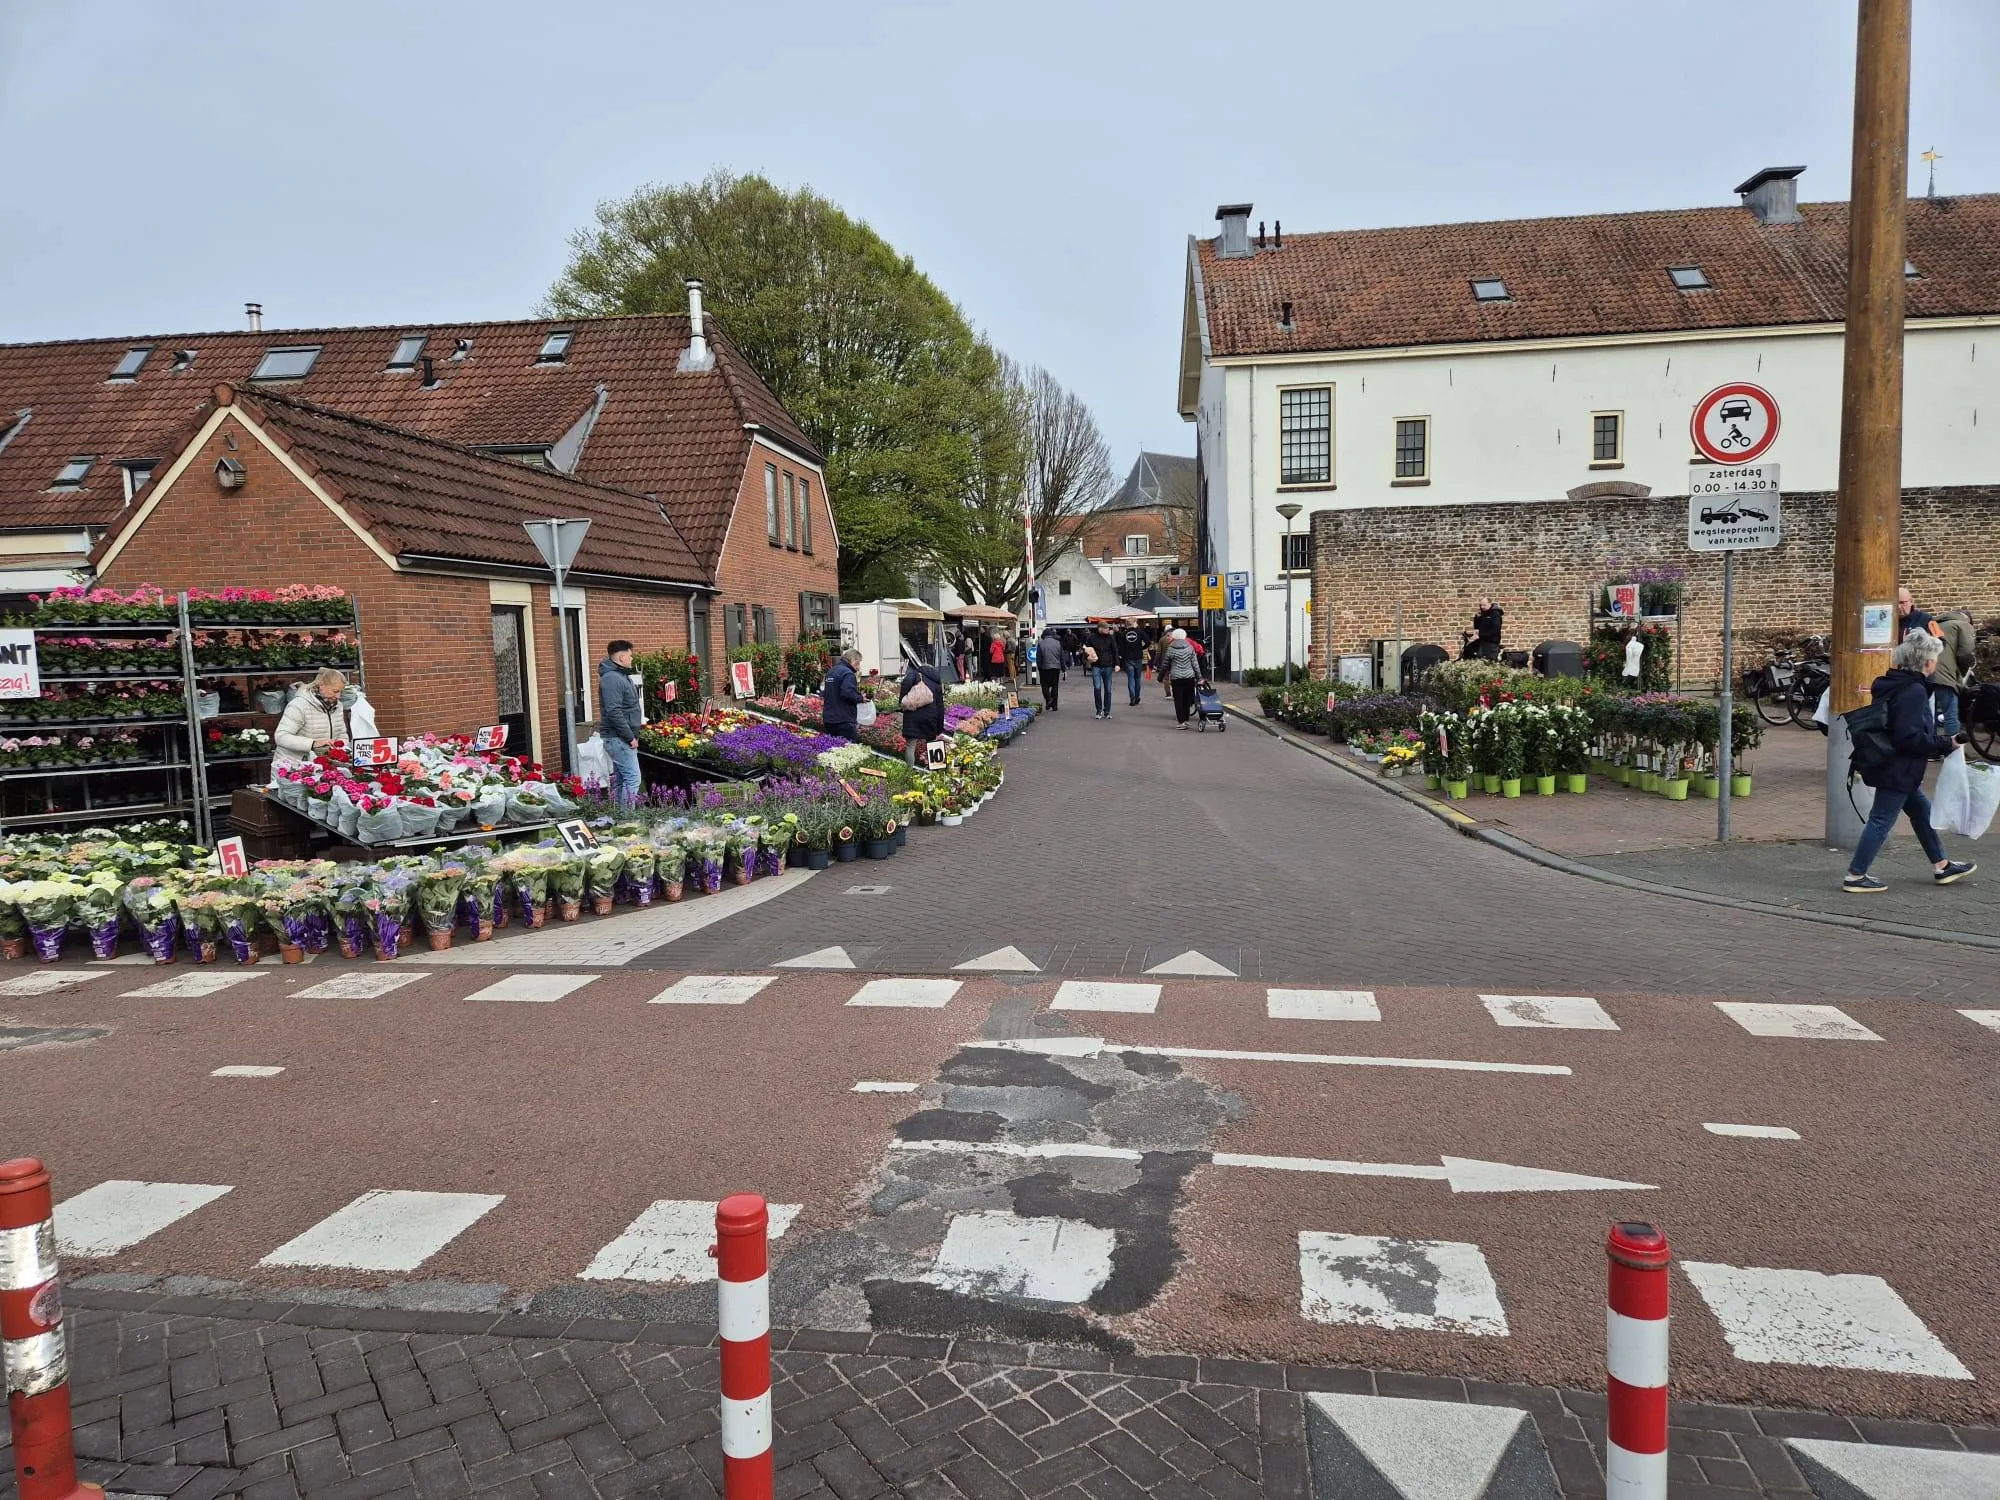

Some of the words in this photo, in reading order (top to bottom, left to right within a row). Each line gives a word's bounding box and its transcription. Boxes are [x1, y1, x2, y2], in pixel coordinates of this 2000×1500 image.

[1709, 467, 1762, 479] zaterdag
[1693, 483, 1721, 493] 0.00
[1734, 480, 1766, 490] 14.30
[1770, 479, 1777, 489] h
[1693, 526, 1775, 536] wegsleepregeling
[1708, 537, 1725, 545] van
[1727, 536, 1760, 544] kracht
[1208, 577, 1216, 586] P
[1233, 590, 1242, 601] P
